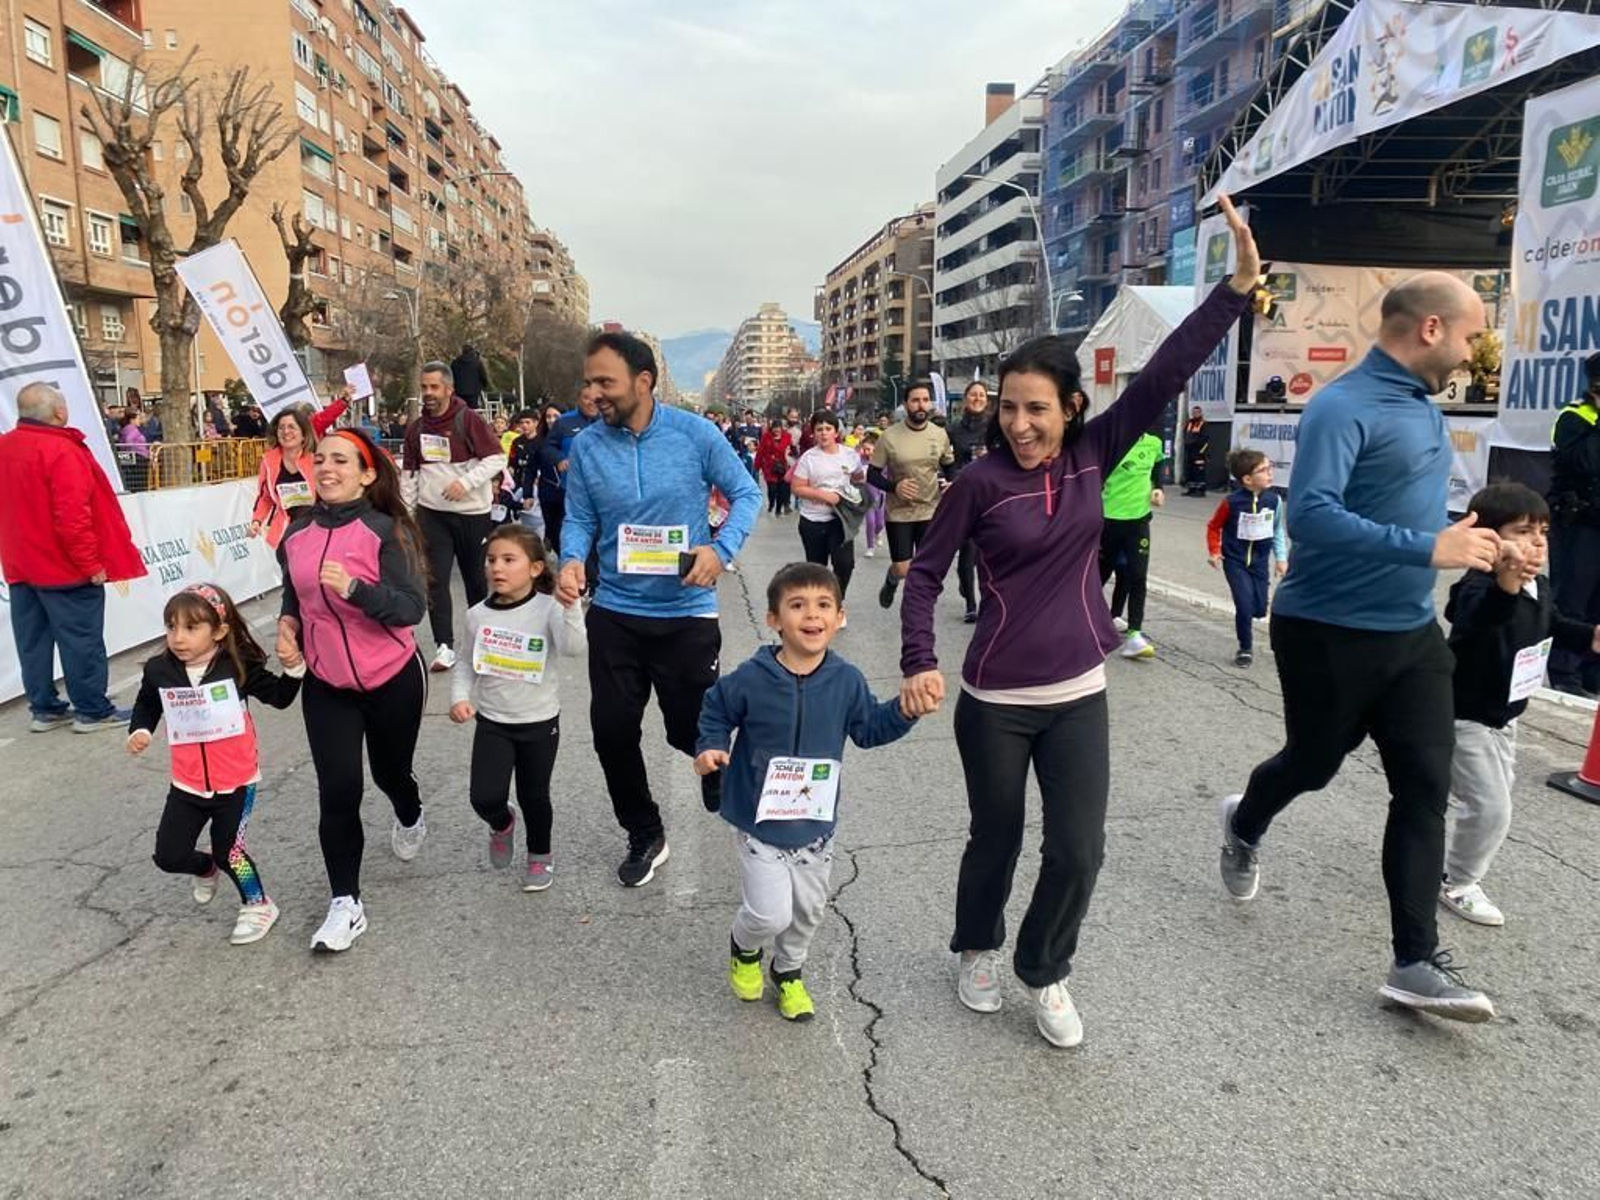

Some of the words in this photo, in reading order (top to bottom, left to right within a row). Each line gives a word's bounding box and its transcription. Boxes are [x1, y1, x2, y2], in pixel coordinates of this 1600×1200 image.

[1331, 45, 1361, 90] SAN
[1540, 295, 1600, 352] SAN
[1448, 382, 1457, 400] 3
[157, 538, 191, 561] RURAL
[483, 637, 498, 645] SAN
